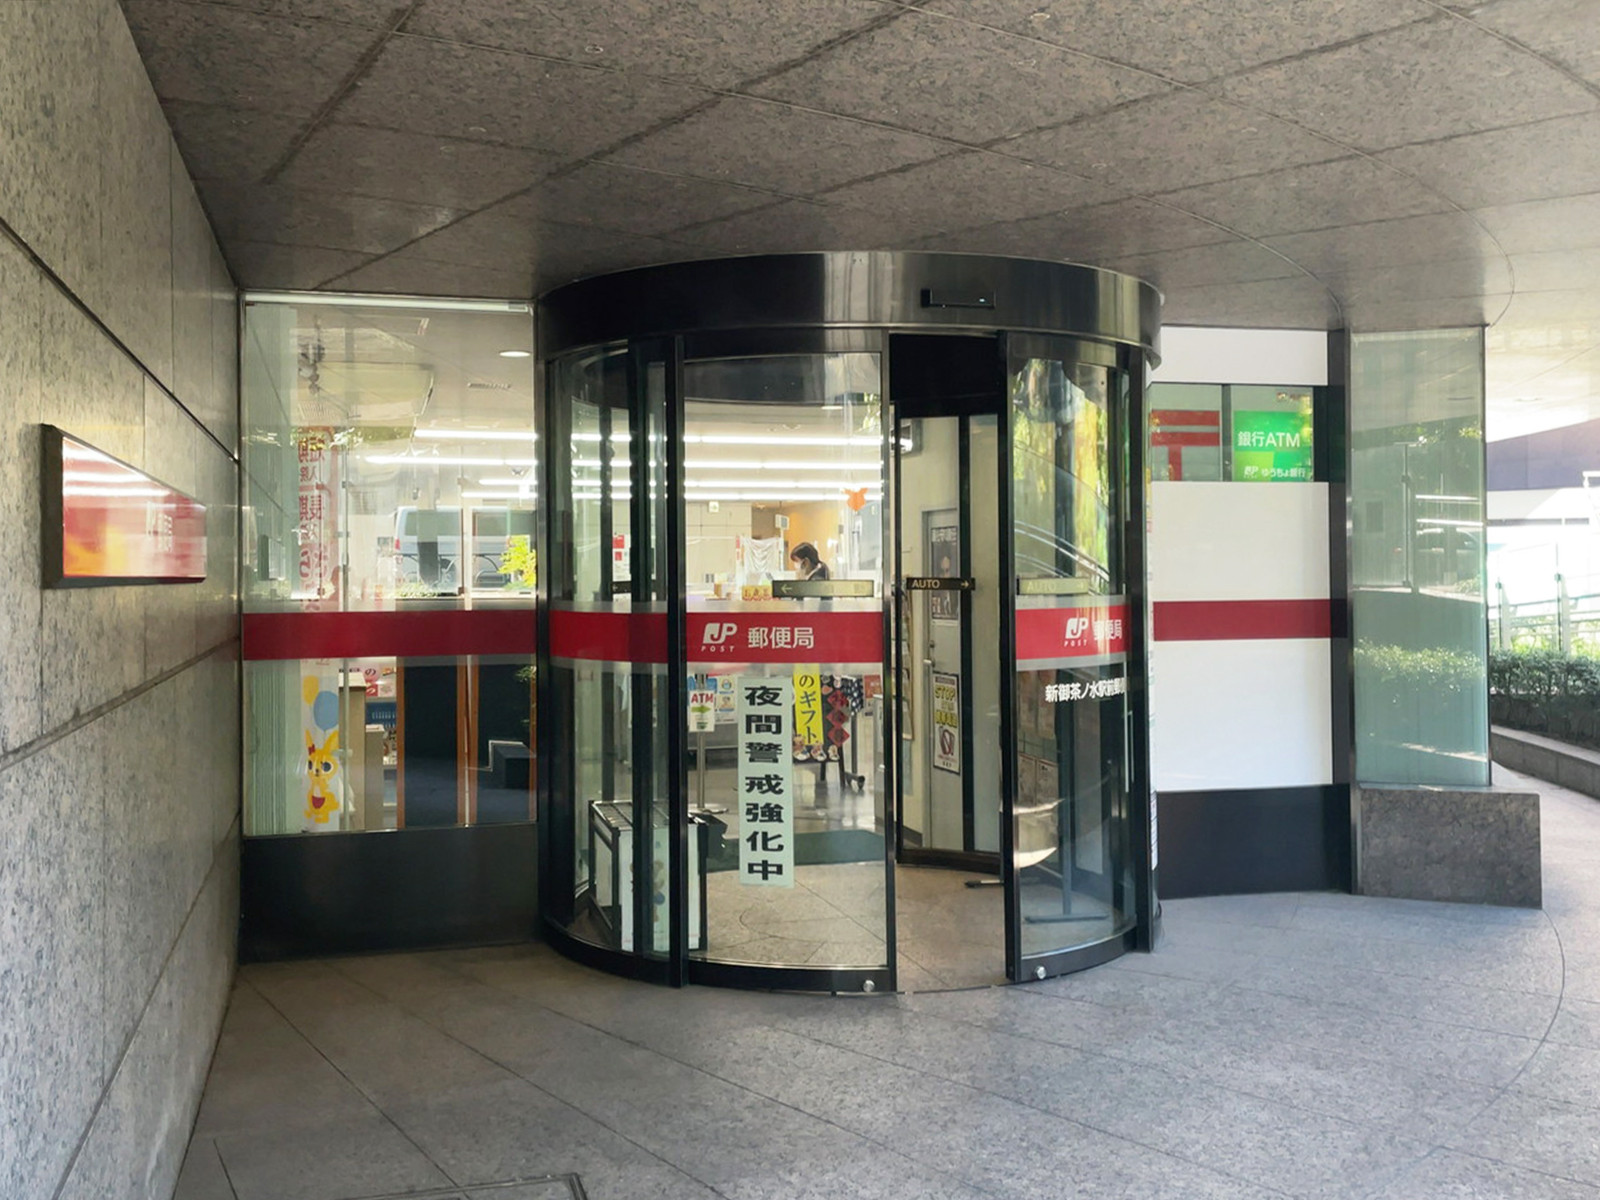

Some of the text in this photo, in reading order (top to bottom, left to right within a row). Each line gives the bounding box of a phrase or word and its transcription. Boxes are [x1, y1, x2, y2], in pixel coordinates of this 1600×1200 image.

[1237, 431, 1301, 448] 銀行ATM
[1261, 467, 1306, 478] ゆうちょ銀行
[912, 579, 941, 589] AUTO
[702, 622, 738, 645] JP
[1065, 617, 1089, 639] JP
[747, 627, 815, 649] 郵便局
[1063, 640, 1088, 648] POST
[701, 645, 736, 653] POST
[691, 693, 714, 704] ATM
[744, 685, 784, 881] 夜間警戒強化中
